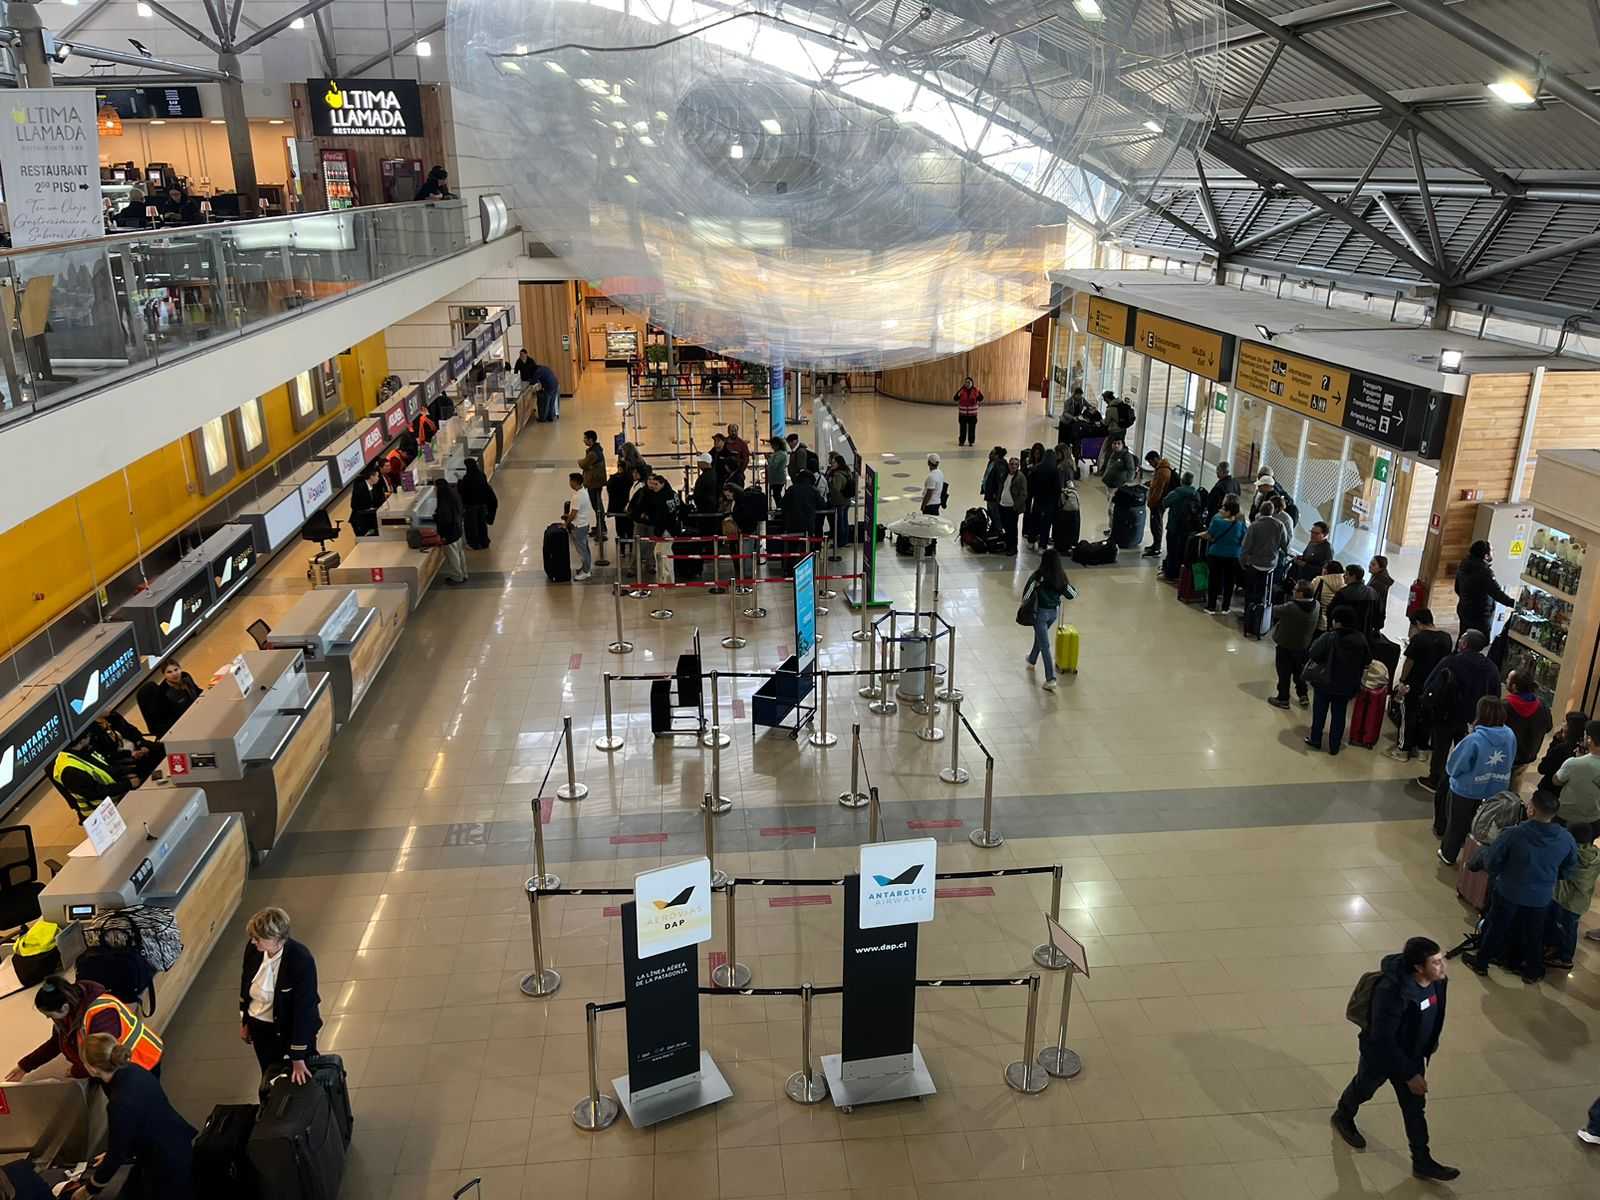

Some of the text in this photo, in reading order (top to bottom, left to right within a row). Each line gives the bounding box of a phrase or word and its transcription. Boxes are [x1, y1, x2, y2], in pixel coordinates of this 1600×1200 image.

[330, 109, 405, 127] LLAMADA
[16, 125, 86, 142] LLAMADA
[20, 165, 88, 176] RESTAURANT
[53, 182, 76, 193] PISO
[100, 648, 134, 683] ANTARCTIC
[105, 661, 134, 688] AIRWAYS
[16, 715, 59, 760] ANTARCTIC
[22, 728, 60, 766] AIRWAYS
[869, 888, 928, 900] ANTARCTIC
[664, 920, 686, 930] DAP
[855, 941, 908, 954] www.dap.cl
